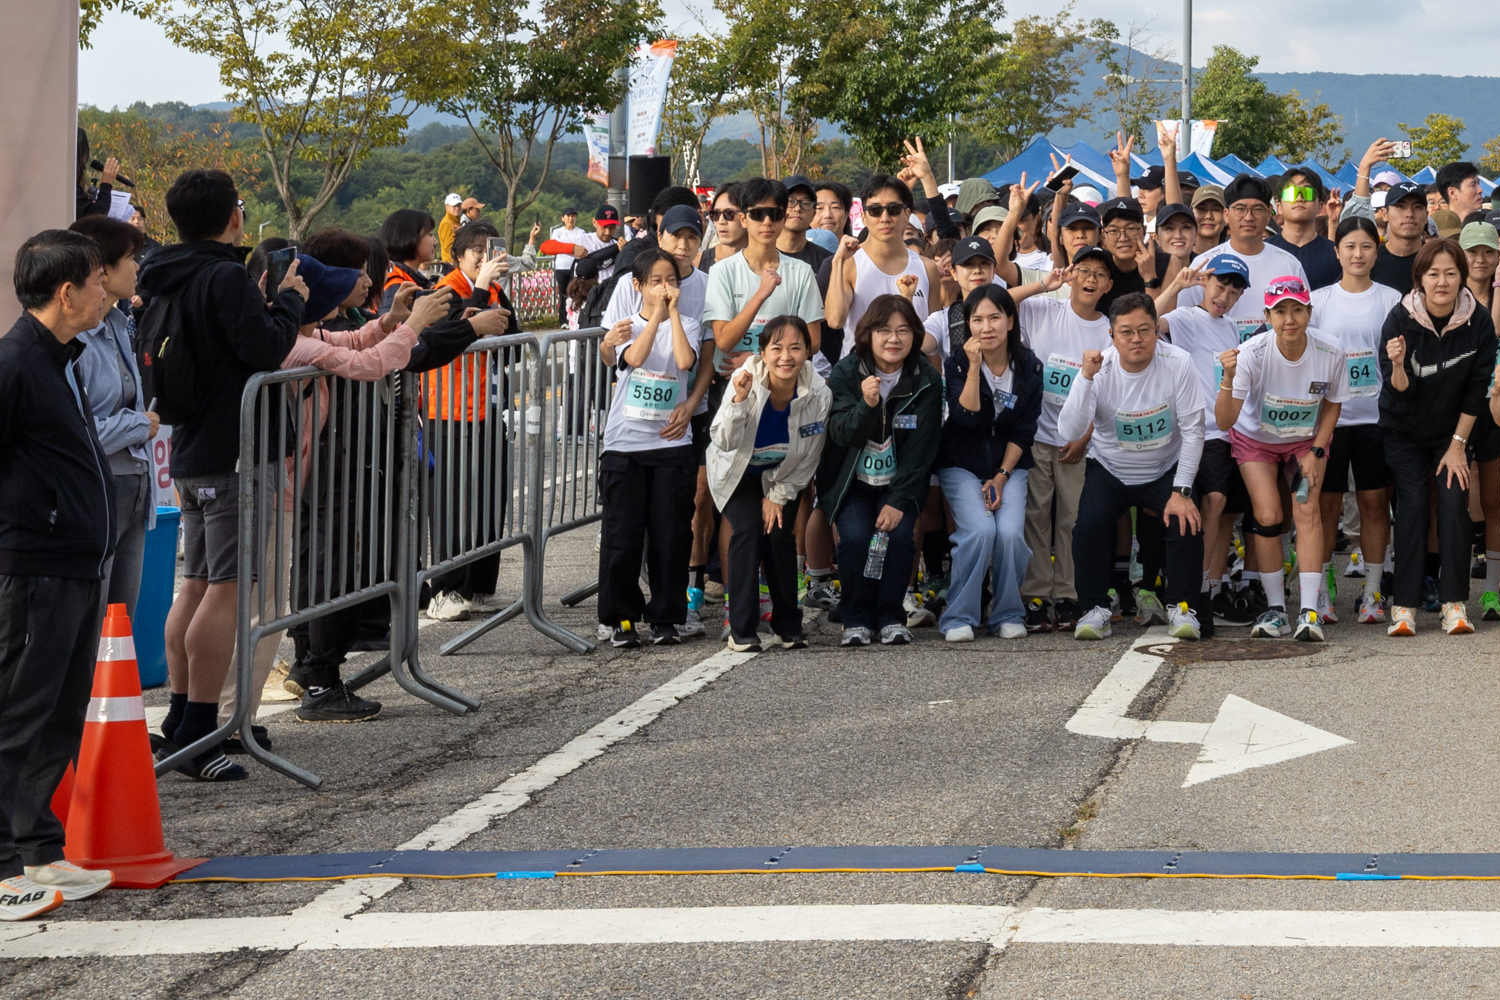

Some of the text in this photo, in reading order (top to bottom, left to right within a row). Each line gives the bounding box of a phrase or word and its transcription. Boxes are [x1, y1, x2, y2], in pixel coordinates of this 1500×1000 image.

[743, 332, 761, 346] 51
[1350, 364, 1370, 379] 64
[1049, 371, 1071, 388] 50
[633, 384, 673, 402] 5580
[1268, 409, 1311, 421] 0007
[1123, 418, 1167, 436] 5112
[864, 455, 897, 470] 000
